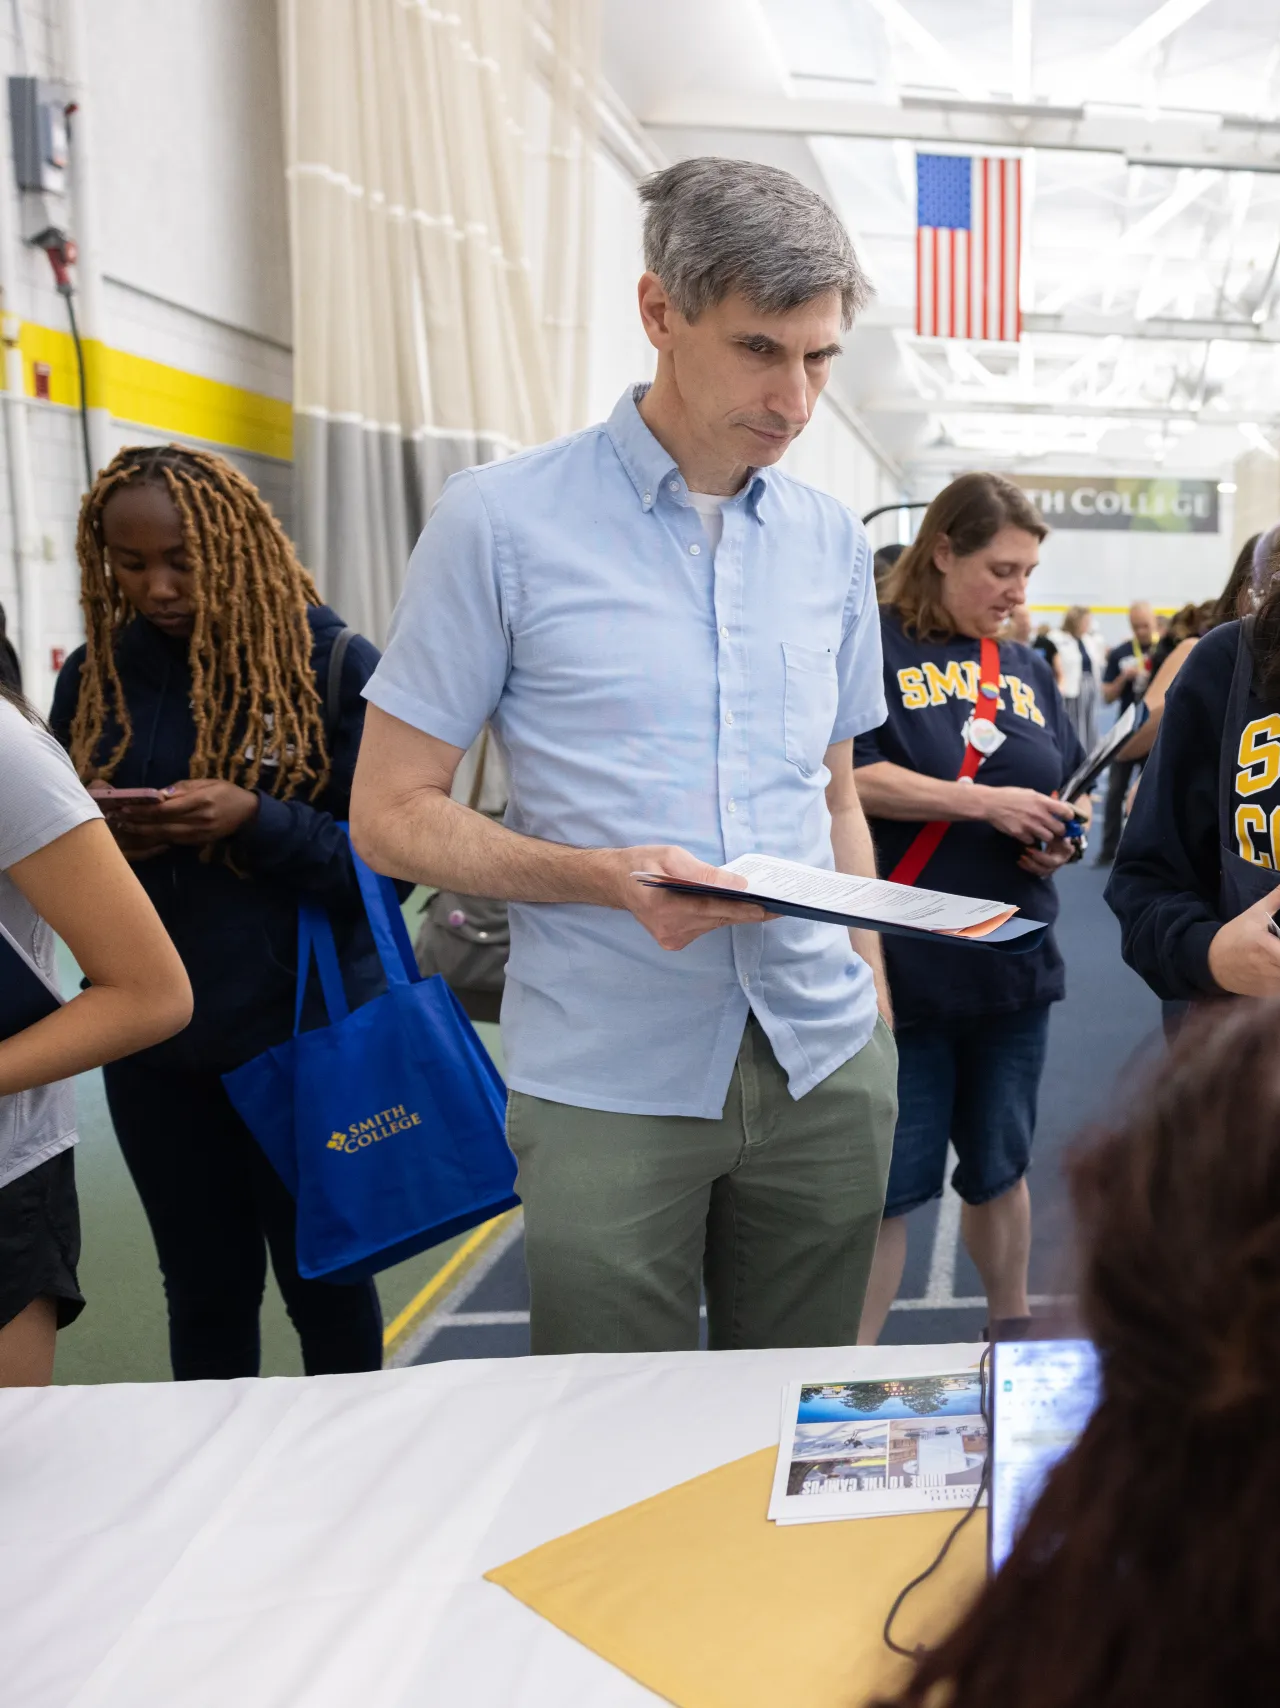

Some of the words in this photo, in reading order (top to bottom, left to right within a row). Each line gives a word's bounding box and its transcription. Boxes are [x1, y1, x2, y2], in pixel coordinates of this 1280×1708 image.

[897, 660, 1046, 728] SMIH
[344, 1112, 422, 1154] COLLEGE
[348, 1104, 407, 1138] SMITH
[802, 1479, 858, 1496] CAMPUS
[862, 1477, 885, 1491] THE
[931, 1493, 977, 1502] MITH
